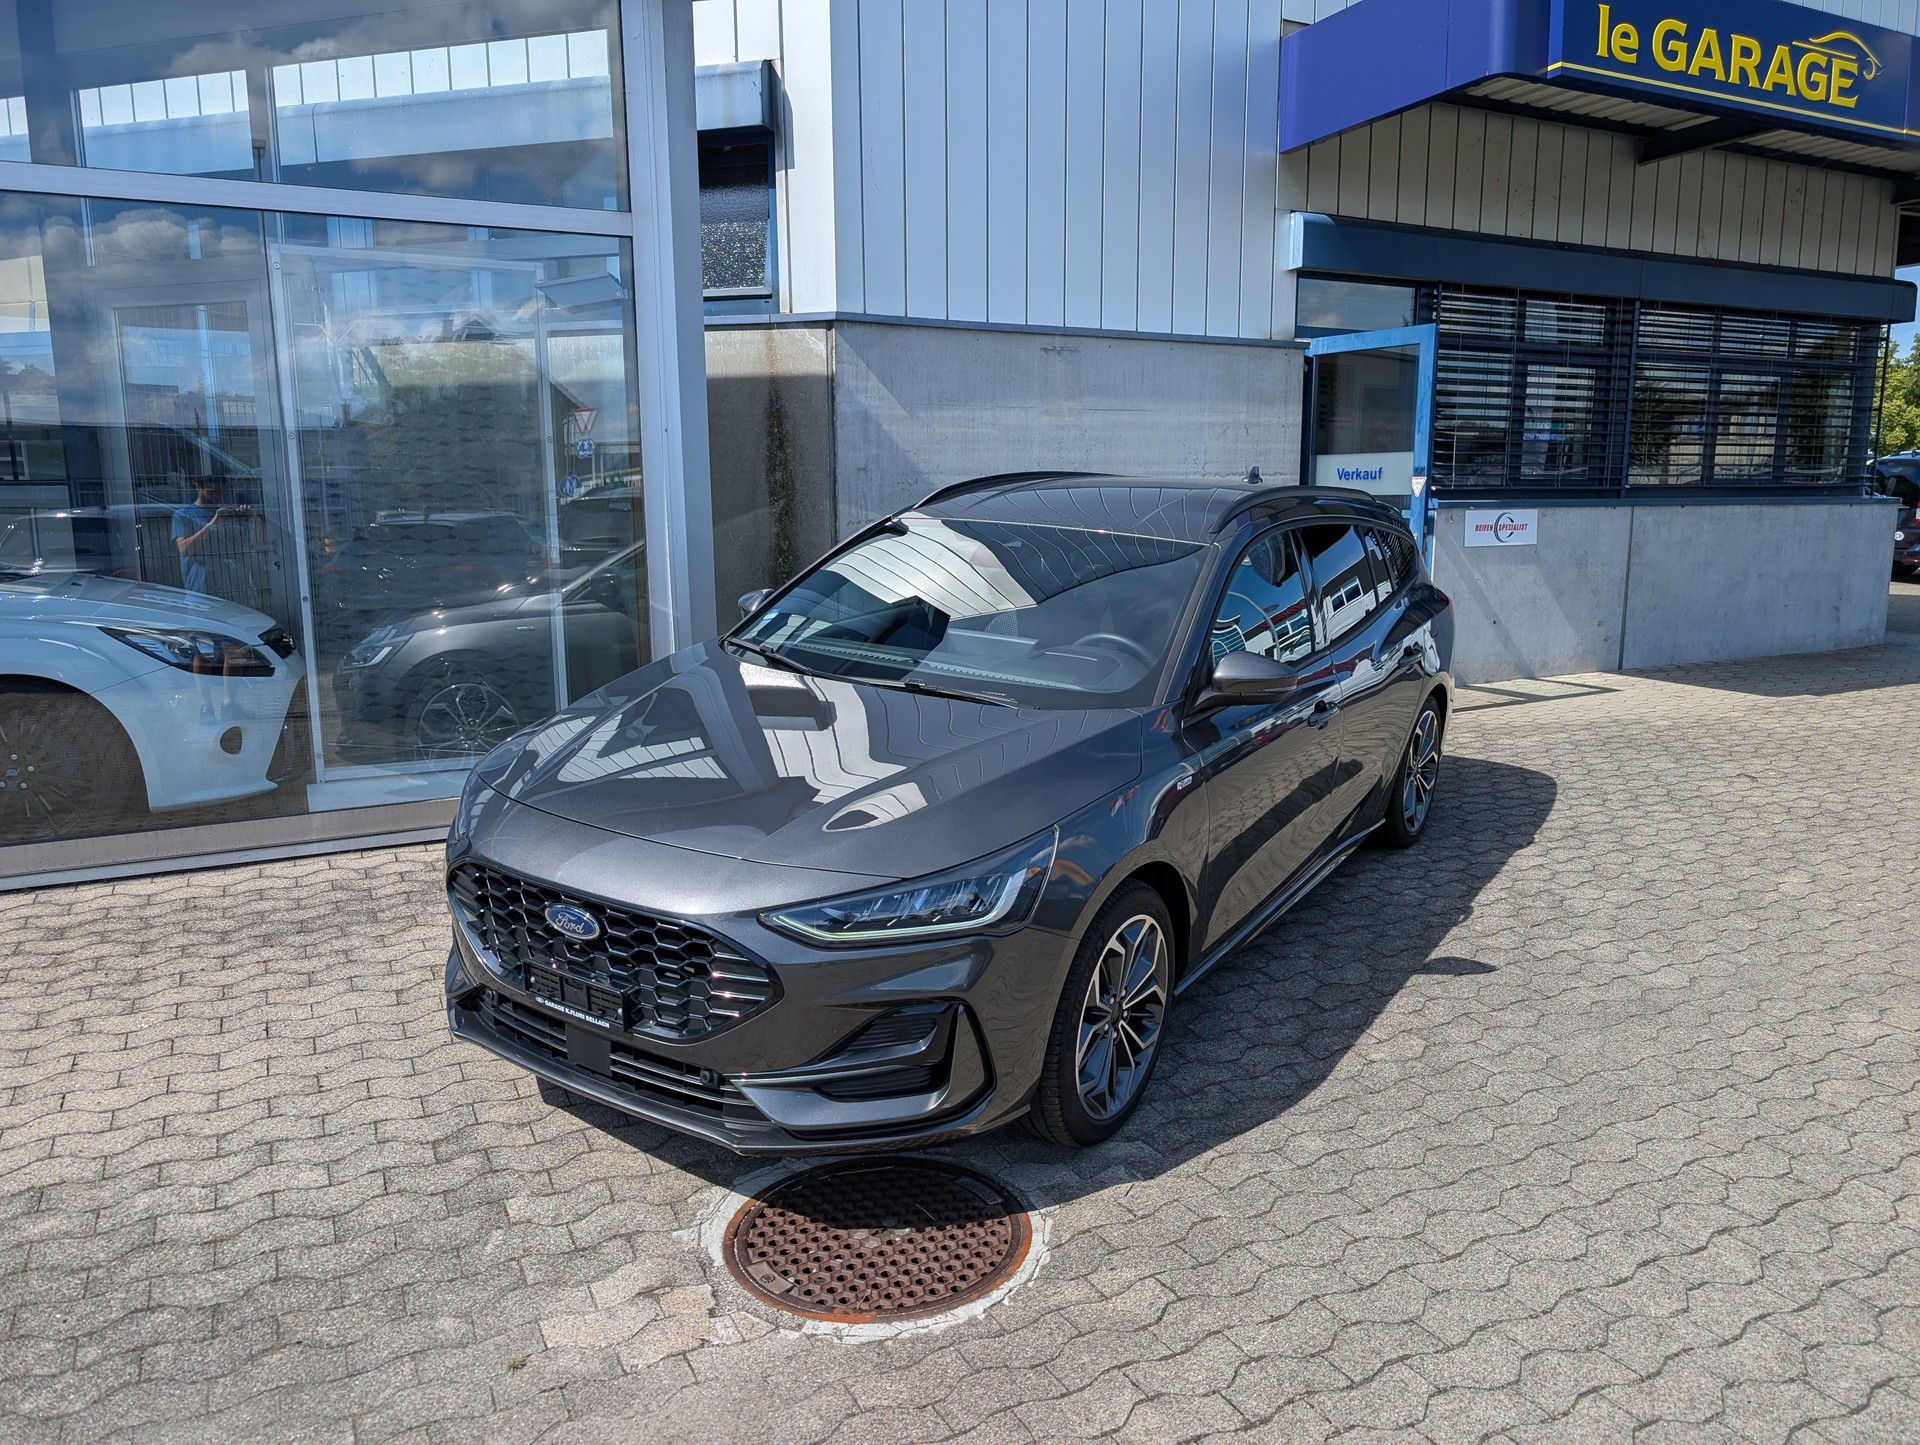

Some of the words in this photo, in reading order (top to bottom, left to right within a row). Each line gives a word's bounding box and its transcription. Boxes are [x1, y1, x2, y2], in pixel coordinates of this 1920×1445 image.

[1597, 4, 1639, 64] le
[1652, 19, 1858, 108] GARAGE
[1336, 467, 1383, 481] Verkauf
[1474, 524, 1494, 532] REIFEN
[1498, 523, 1528, 531] SPEZIALIST
[555, 913, 585, 934] Ford
[544, 1000, 564, 1012] GARAGE
